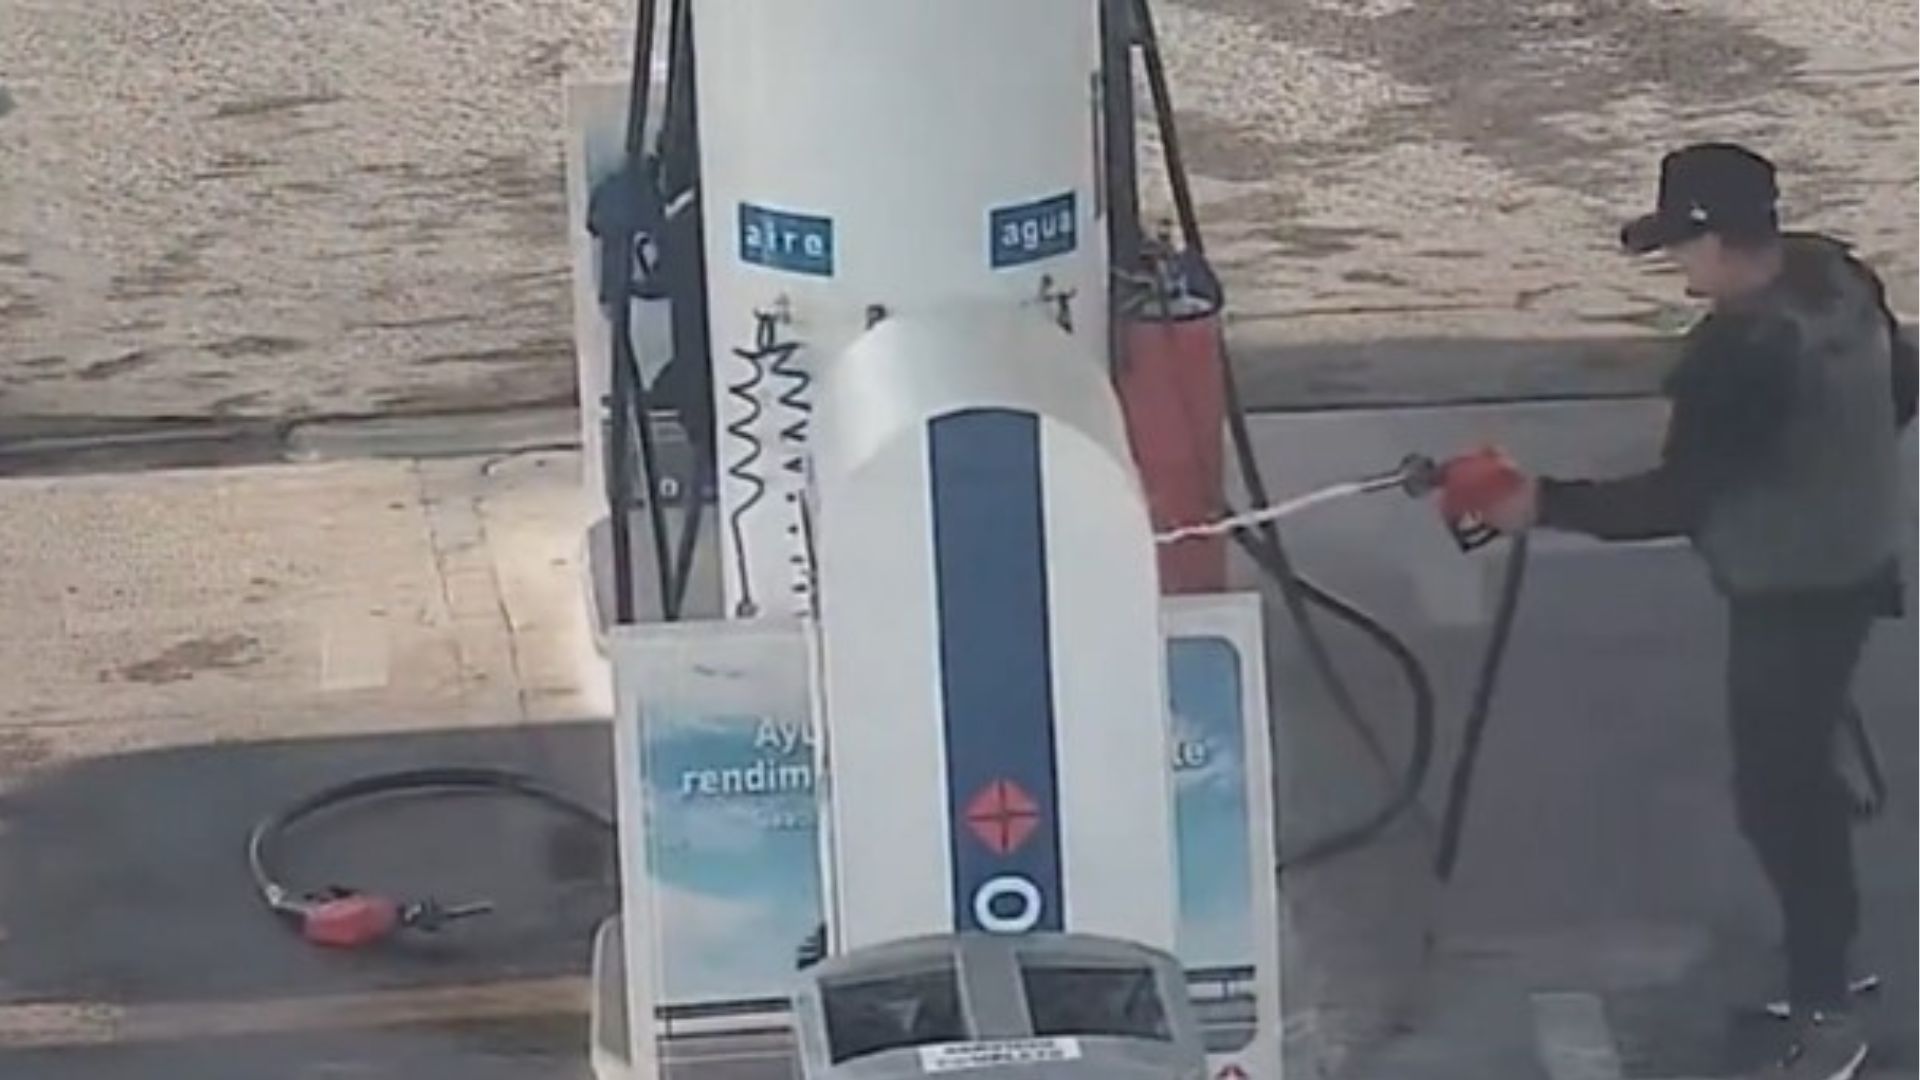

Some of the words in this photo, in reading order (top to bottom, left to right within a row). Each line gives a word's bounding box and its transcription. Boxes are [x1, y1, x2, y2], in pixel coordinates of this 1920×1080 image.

[746, 221, 823, 256] aire
[1001, 211, 1071, 250] agua
[683, 759, 811, 794] rendim
